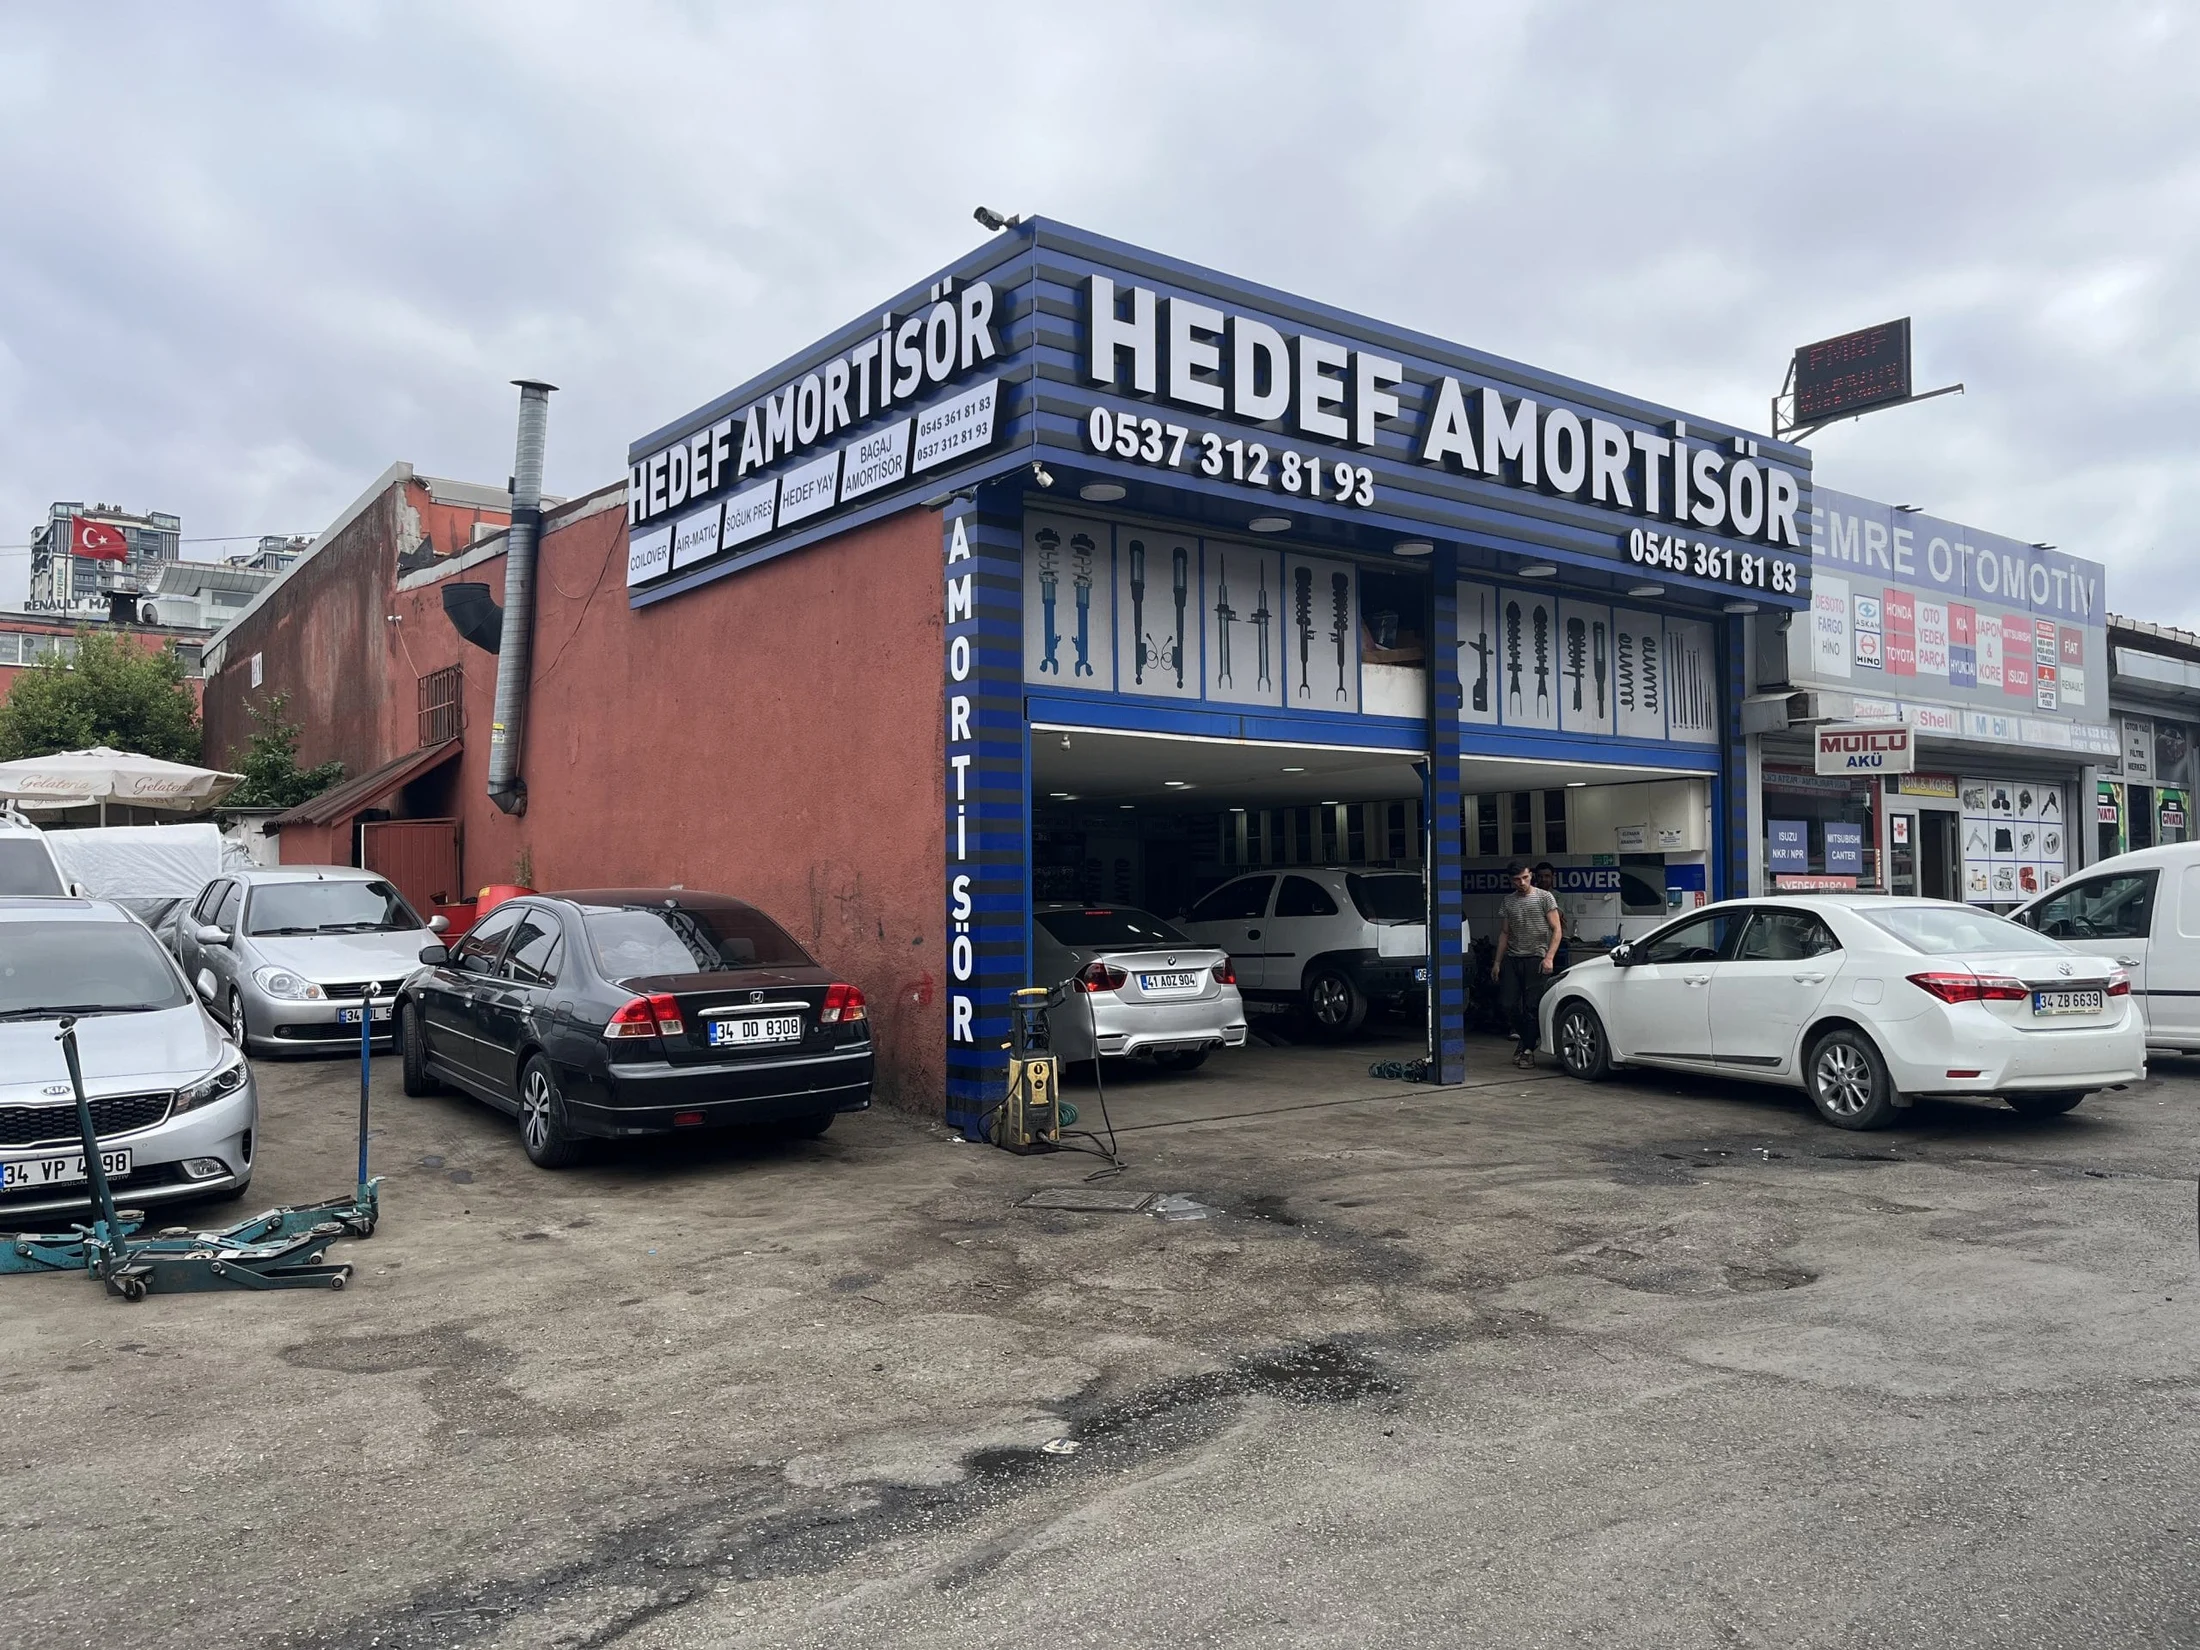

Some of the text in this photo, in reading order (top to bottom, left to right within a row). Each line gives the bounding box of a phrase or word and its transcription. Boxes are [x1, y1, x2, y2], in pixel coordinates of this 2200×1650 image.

[629, 275, 996, 525] HEDEF AMORTİSÖR
[920, 396, 991, 437] 0545 361 81 83
[1090, 273, 1801, 547] HEDEF AMORTİSÖR
[860, 434, 892, 464] BAGAJ
[917, 422, 987, 461] 0537 312 81 93
[1089, 406, 1375, 507] 0537 312 81 93
[845, 453, 902, 494] AMORTİSÖR
[782, 472, 834, 510] HEDEF YAY
[726, 499, 772, 533] SOĞUK PRES
[676, 523, 717, 553] AIR-MATIC
[631, 545, 667, 571] COILOVER
[1630, 528, 1797, 594] 0545 361 81 83
[1812, 507, 2096, 616] EMRE OTOMOTİV
[24, 599, 111, 611] RENAULT MA
[1815, 594, 1845, 614] DESOTO
[1886, 602, 1912, 620] HONDA
[1856, 619, 1880, 629] ASKAM
[1923, 607, 1940, 625] OTO
[1955, 617, 1968, 631] KIA
[1818, 616, 1843, 635] FARGO
[1976, 619, 2002, 638] JAPON
[1918, 628, 1945, 646] YEDEK
[1886, 647, 1915, 663] TOYOTA
[1986, 643, 1993, 658] &
[1857, 655, 1880, 666] HINO
[1919, 651, 1946, 670] PARÇA
[1950, 659, 1976, 676] HYUNDAI
[1979, 664, 2001, 681] KORE
[2061, 679, 2084, 692] RENAULT
[1920, 711, 1953, 728] Shell
[1976, 716, 2007, 736] Mbil
[1819, 729, 1907, 753] MUTLU
[1846, 755, 1882, 768] AKÜ
[18, 775, 91, 792] Gelateria
[133, 776, 193, 795] Gelateria
[948, 516, 974, 1043] AMORTİSÖR
[1920, 777, 1926, 789] &
[1929, 779, 1953, 792] KORE
[2098, 807, 2116, 821] VATA
[1778, 832, 1797, 841] ISUZU
[1827, 834, 1860, 844] MITSUBISHI
[1772, 850, 1787, 859] NKR
[1790, 850, 1804, 859] NPR
[1831, 851, 1856, 860] CANTER
[1464, 873, 1513, 889] HEDE
[1148, 975, 1158, 987] 41
[1179, 973, 1195, 985] 904
[2040, 991, 2099, 1008] 34 ZB 6639
[347, 1010, 360, 1021] 34
[717, 1019, 798, 1039] 34 DD 8308
[46, 1086, 68, 1094] KIA
[4, 1153, 127, 1185] 34 VP 498
